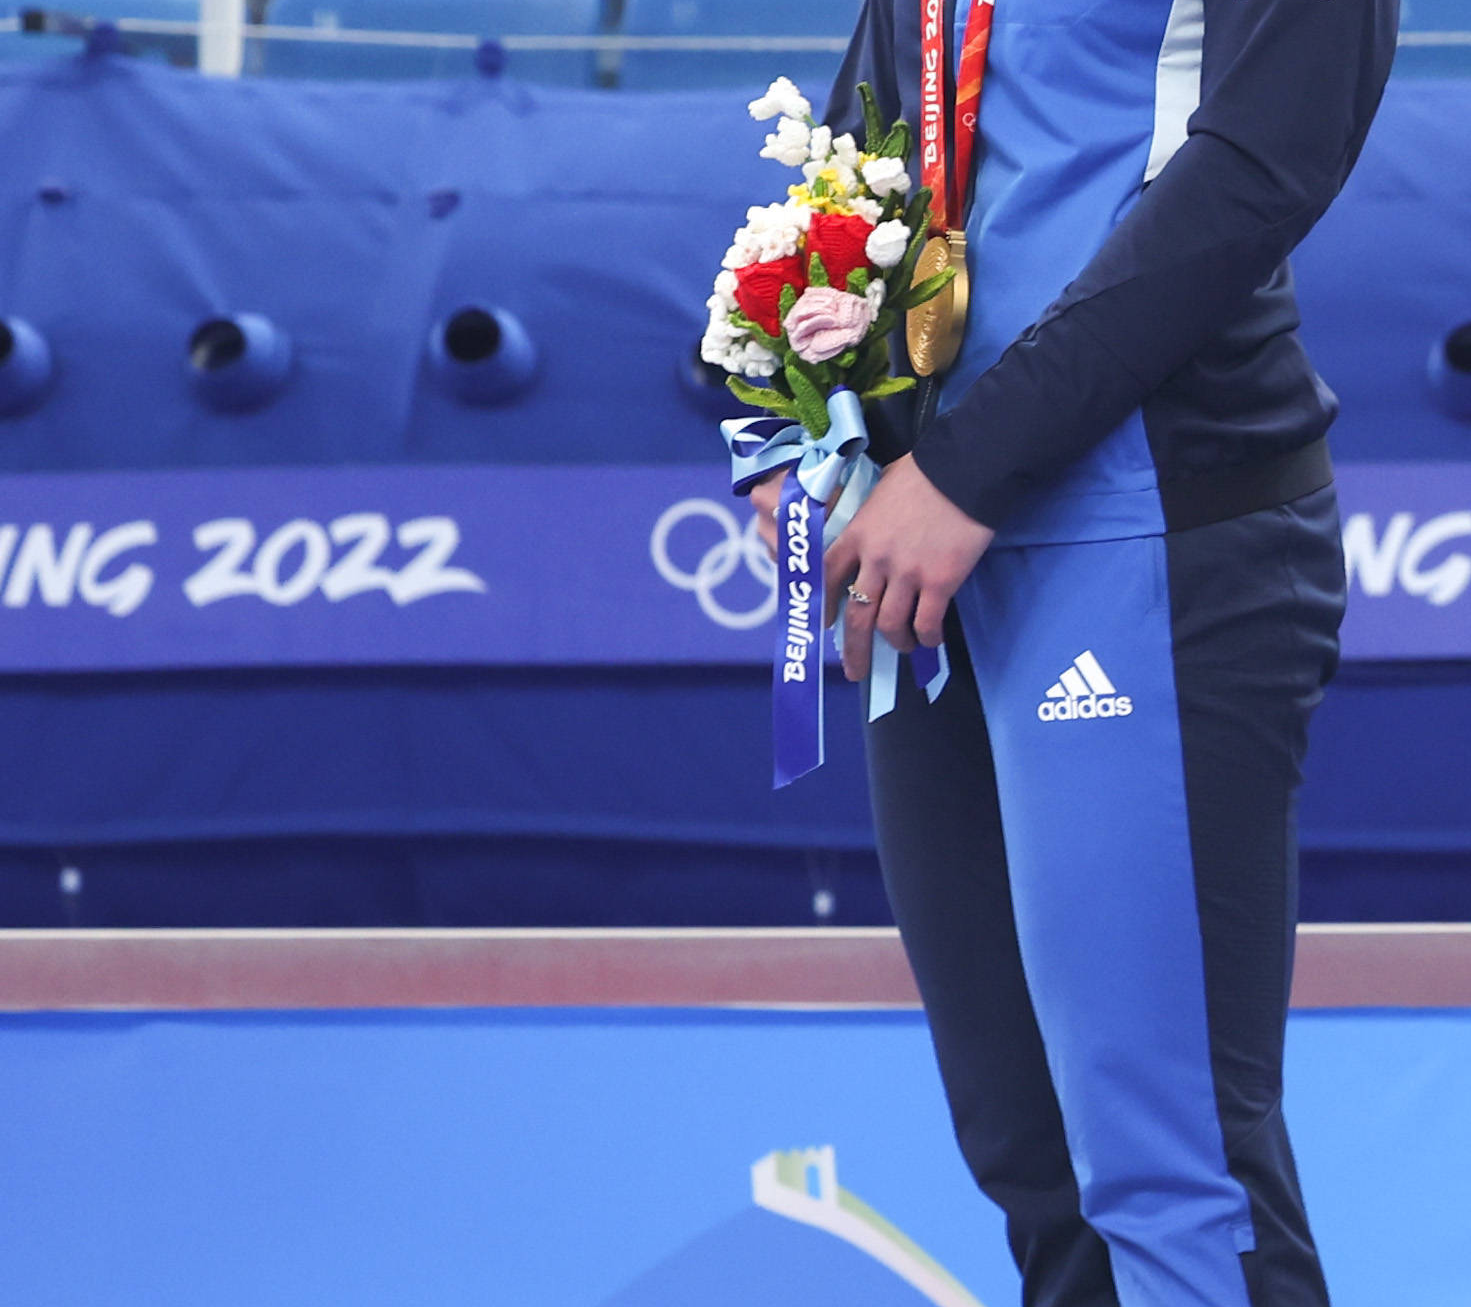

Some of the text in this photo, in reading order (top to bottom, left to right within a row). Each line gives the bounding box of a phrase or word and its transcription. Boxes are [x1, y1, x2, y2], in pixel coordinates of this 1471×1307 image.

[924, 48, 940, 169] BEIJING
[184, 513, 486, 607] 2022
[783, 495, 815, 683] BEIJING 2022
[1037, 693, 1133, 722] adidas
